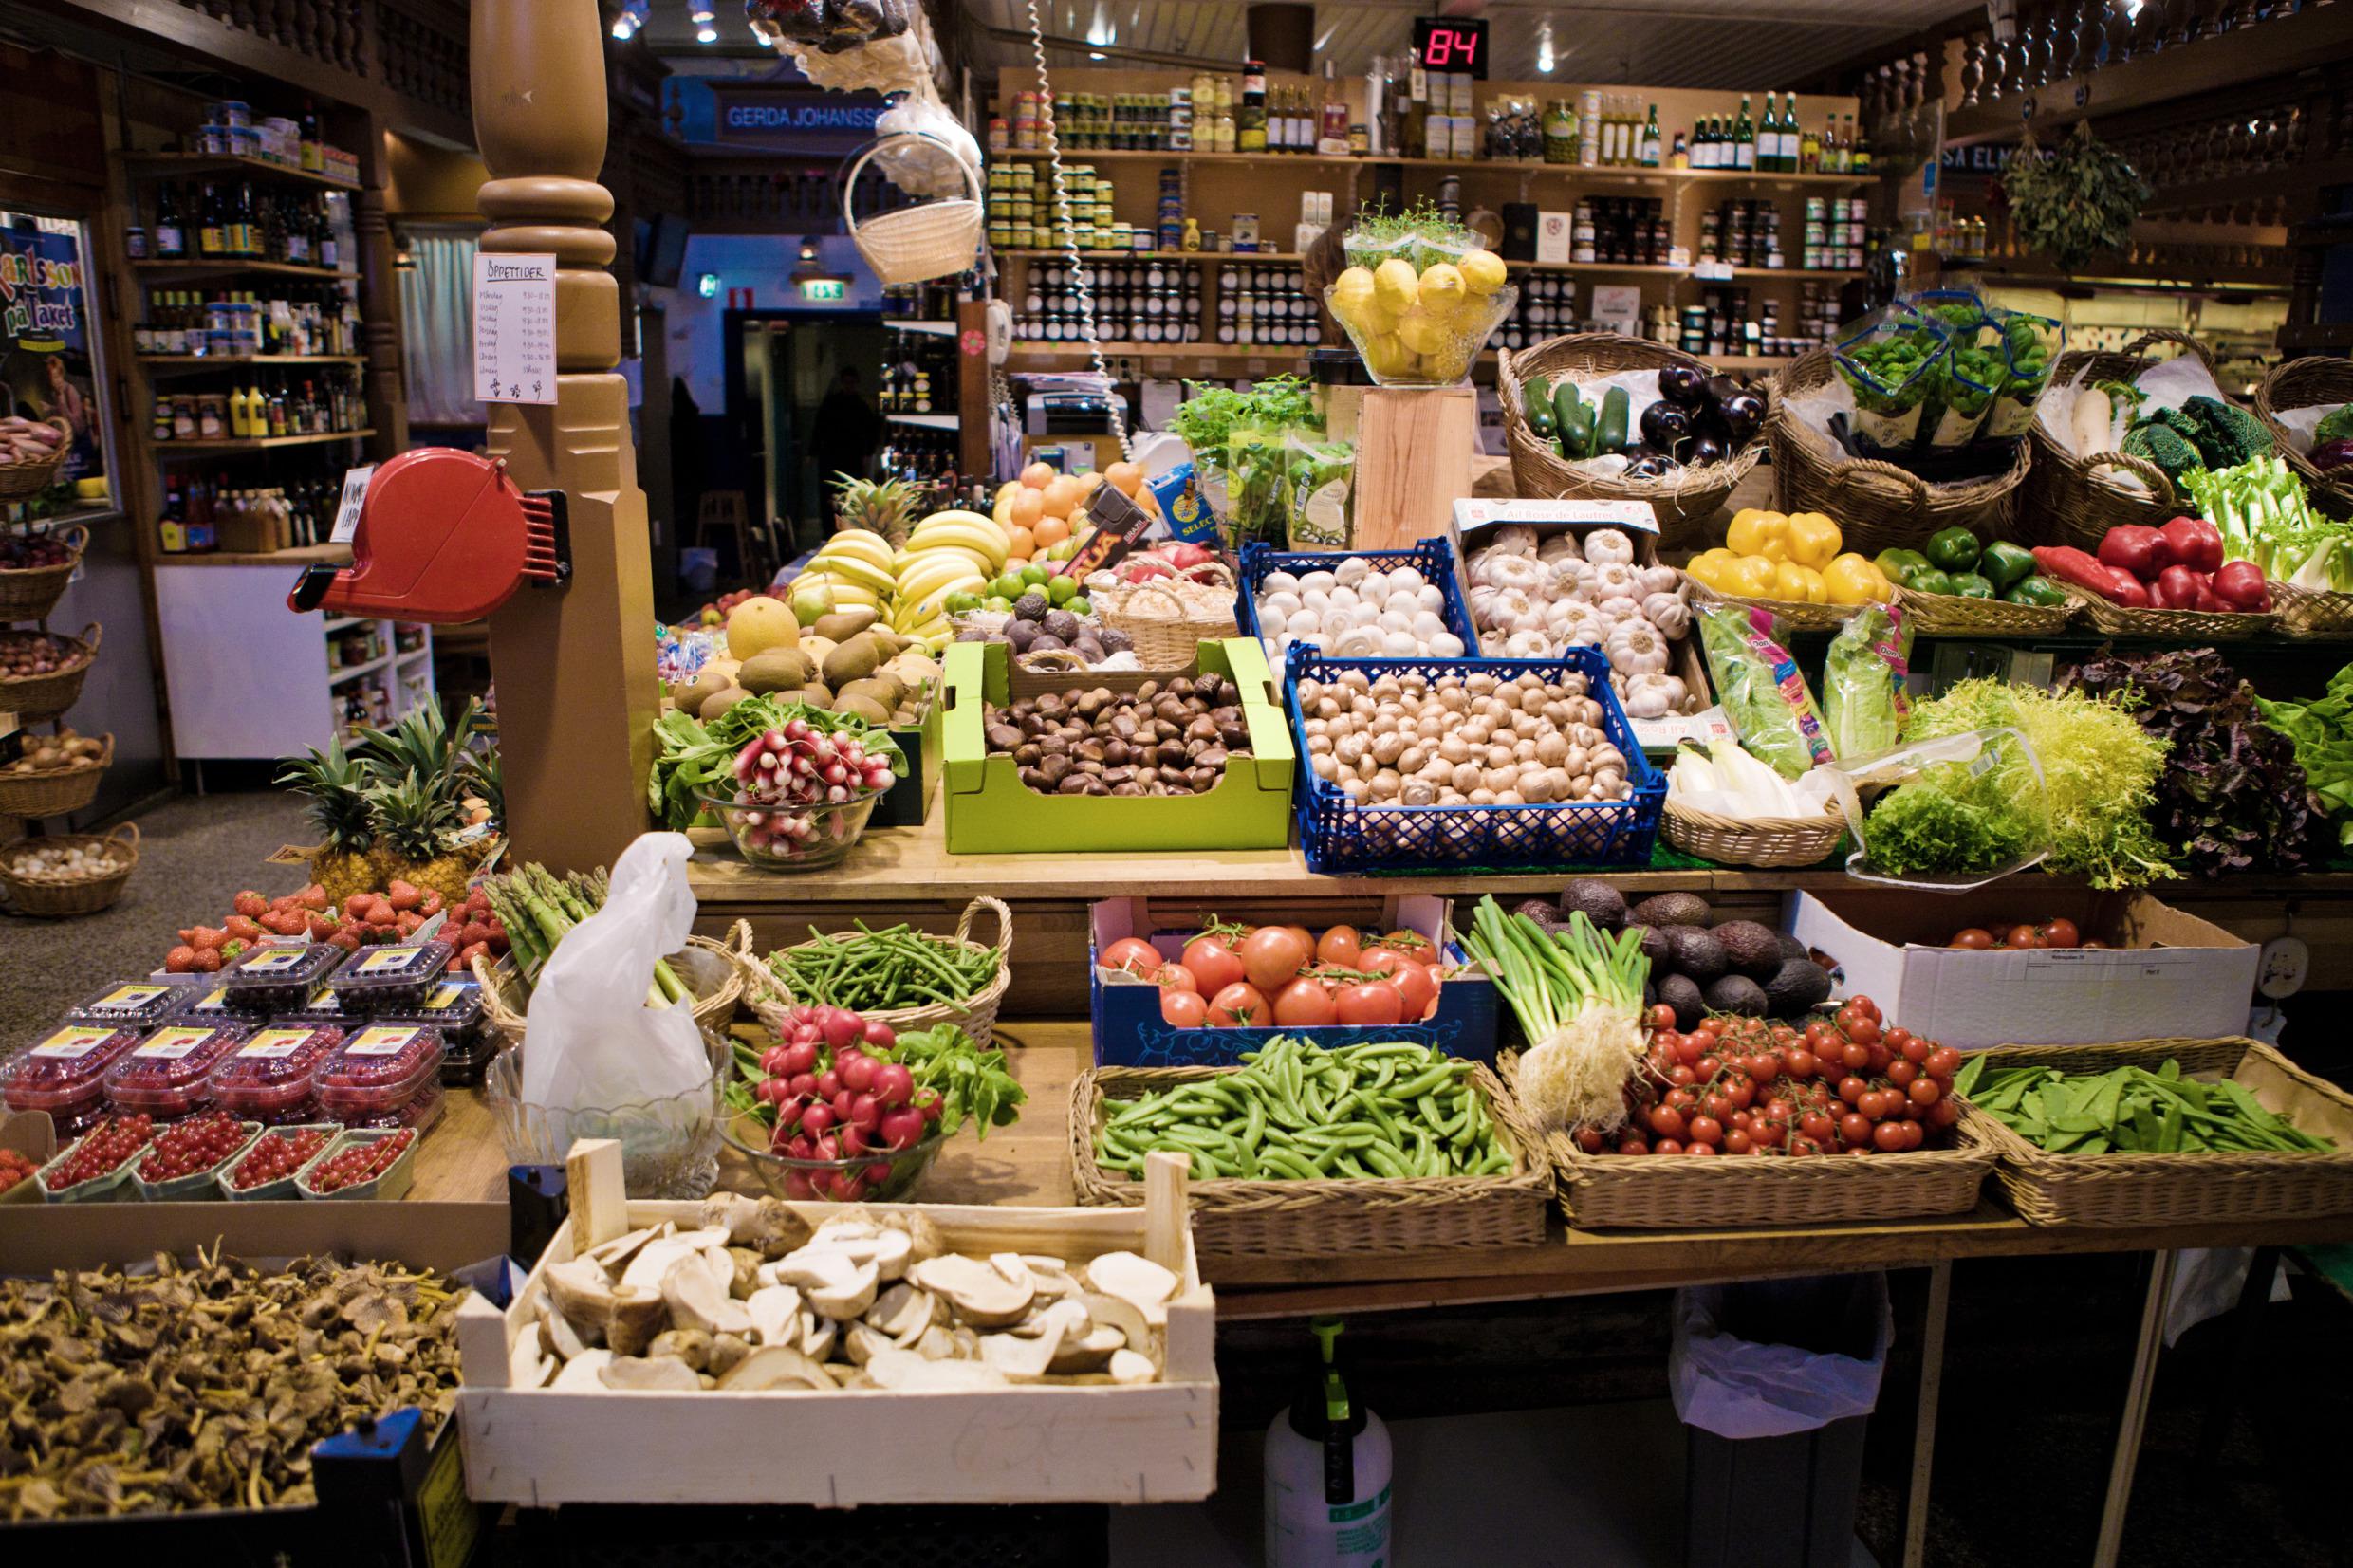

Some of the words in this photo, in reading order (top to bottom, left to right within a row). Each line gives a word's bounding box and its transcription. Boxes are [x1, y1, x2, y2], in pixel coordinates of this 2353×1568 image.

[1425, 28, 1478, 65] 84
[728, 106, 790, 127] GERDA
[487, 259, 545, 279] ÖPPETTIDER
[1506, 509, 1522, 519] Ail
[1525, 509, 1553, 519] Rose
[1555, 509, 1570, 519] de
[1573, 509, 1614, 520] Lautrec
